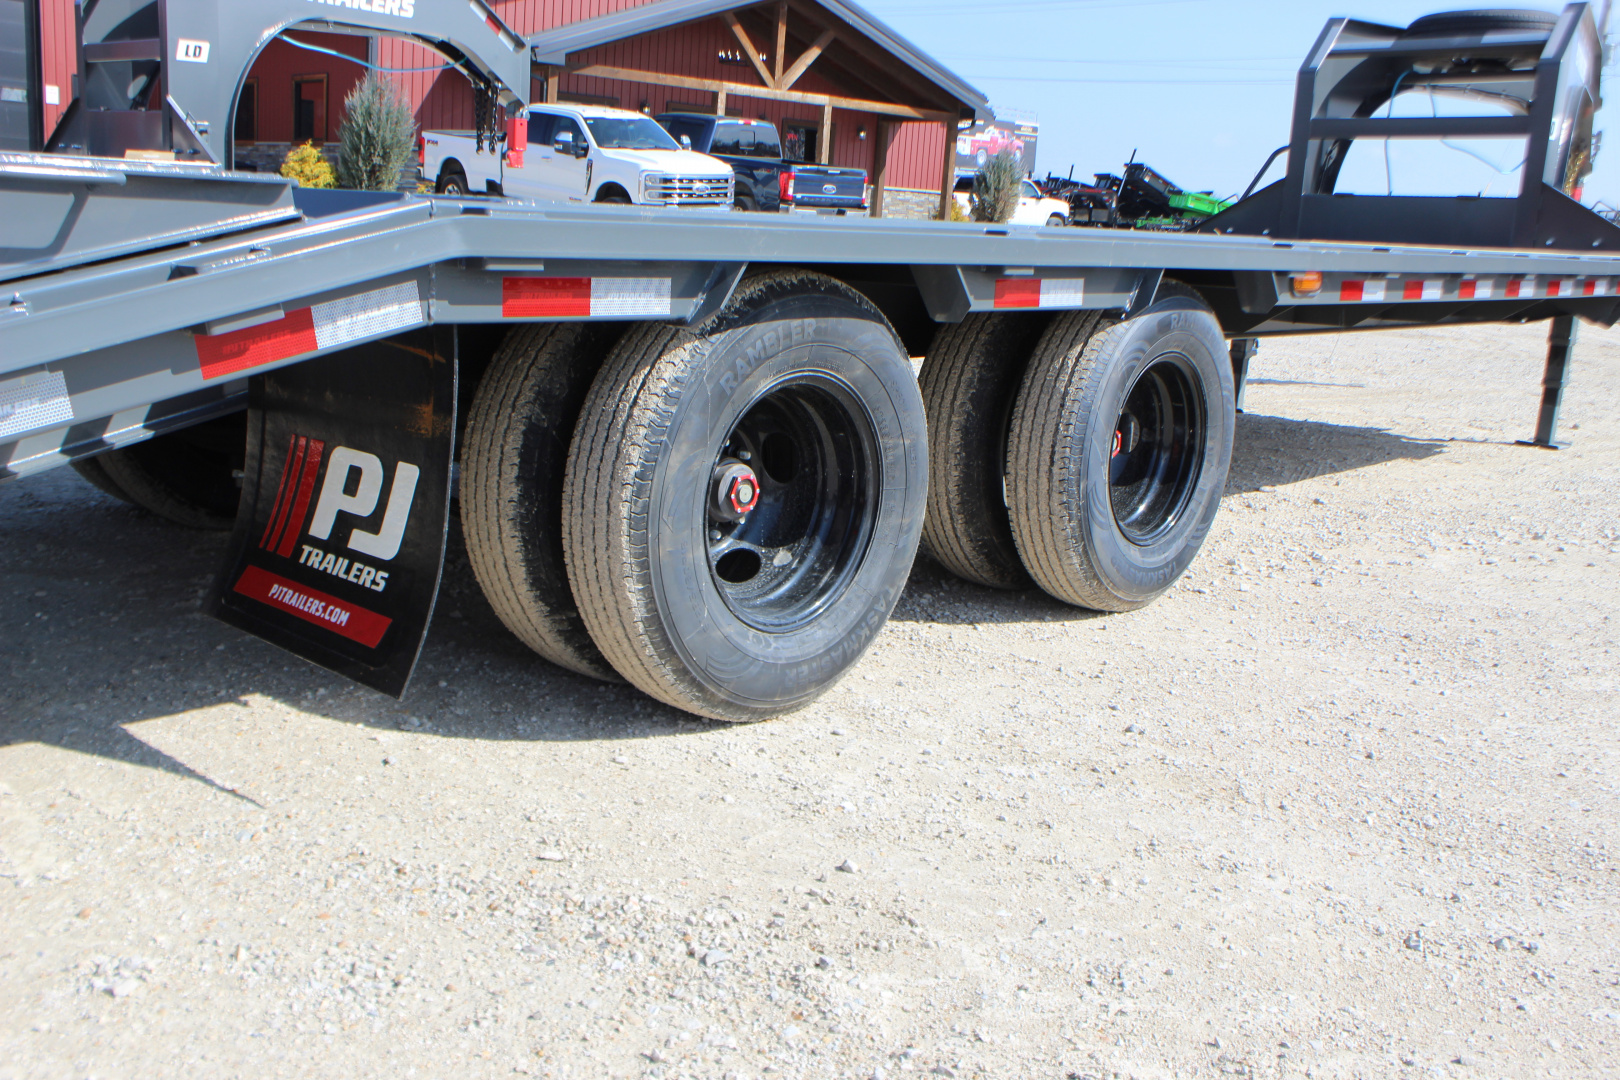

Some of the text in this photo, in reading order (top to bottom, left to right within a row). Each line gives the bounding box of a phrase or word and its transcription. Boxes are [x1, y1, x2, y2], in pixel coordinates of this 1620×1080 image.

[719, 318, 817, 396] RAMBLER
[308, 446, 420, 561] PJ
[299, 545, 389, 592] TRAILERS
[268, 583, 350, 627] PJTRAILERS.COM
